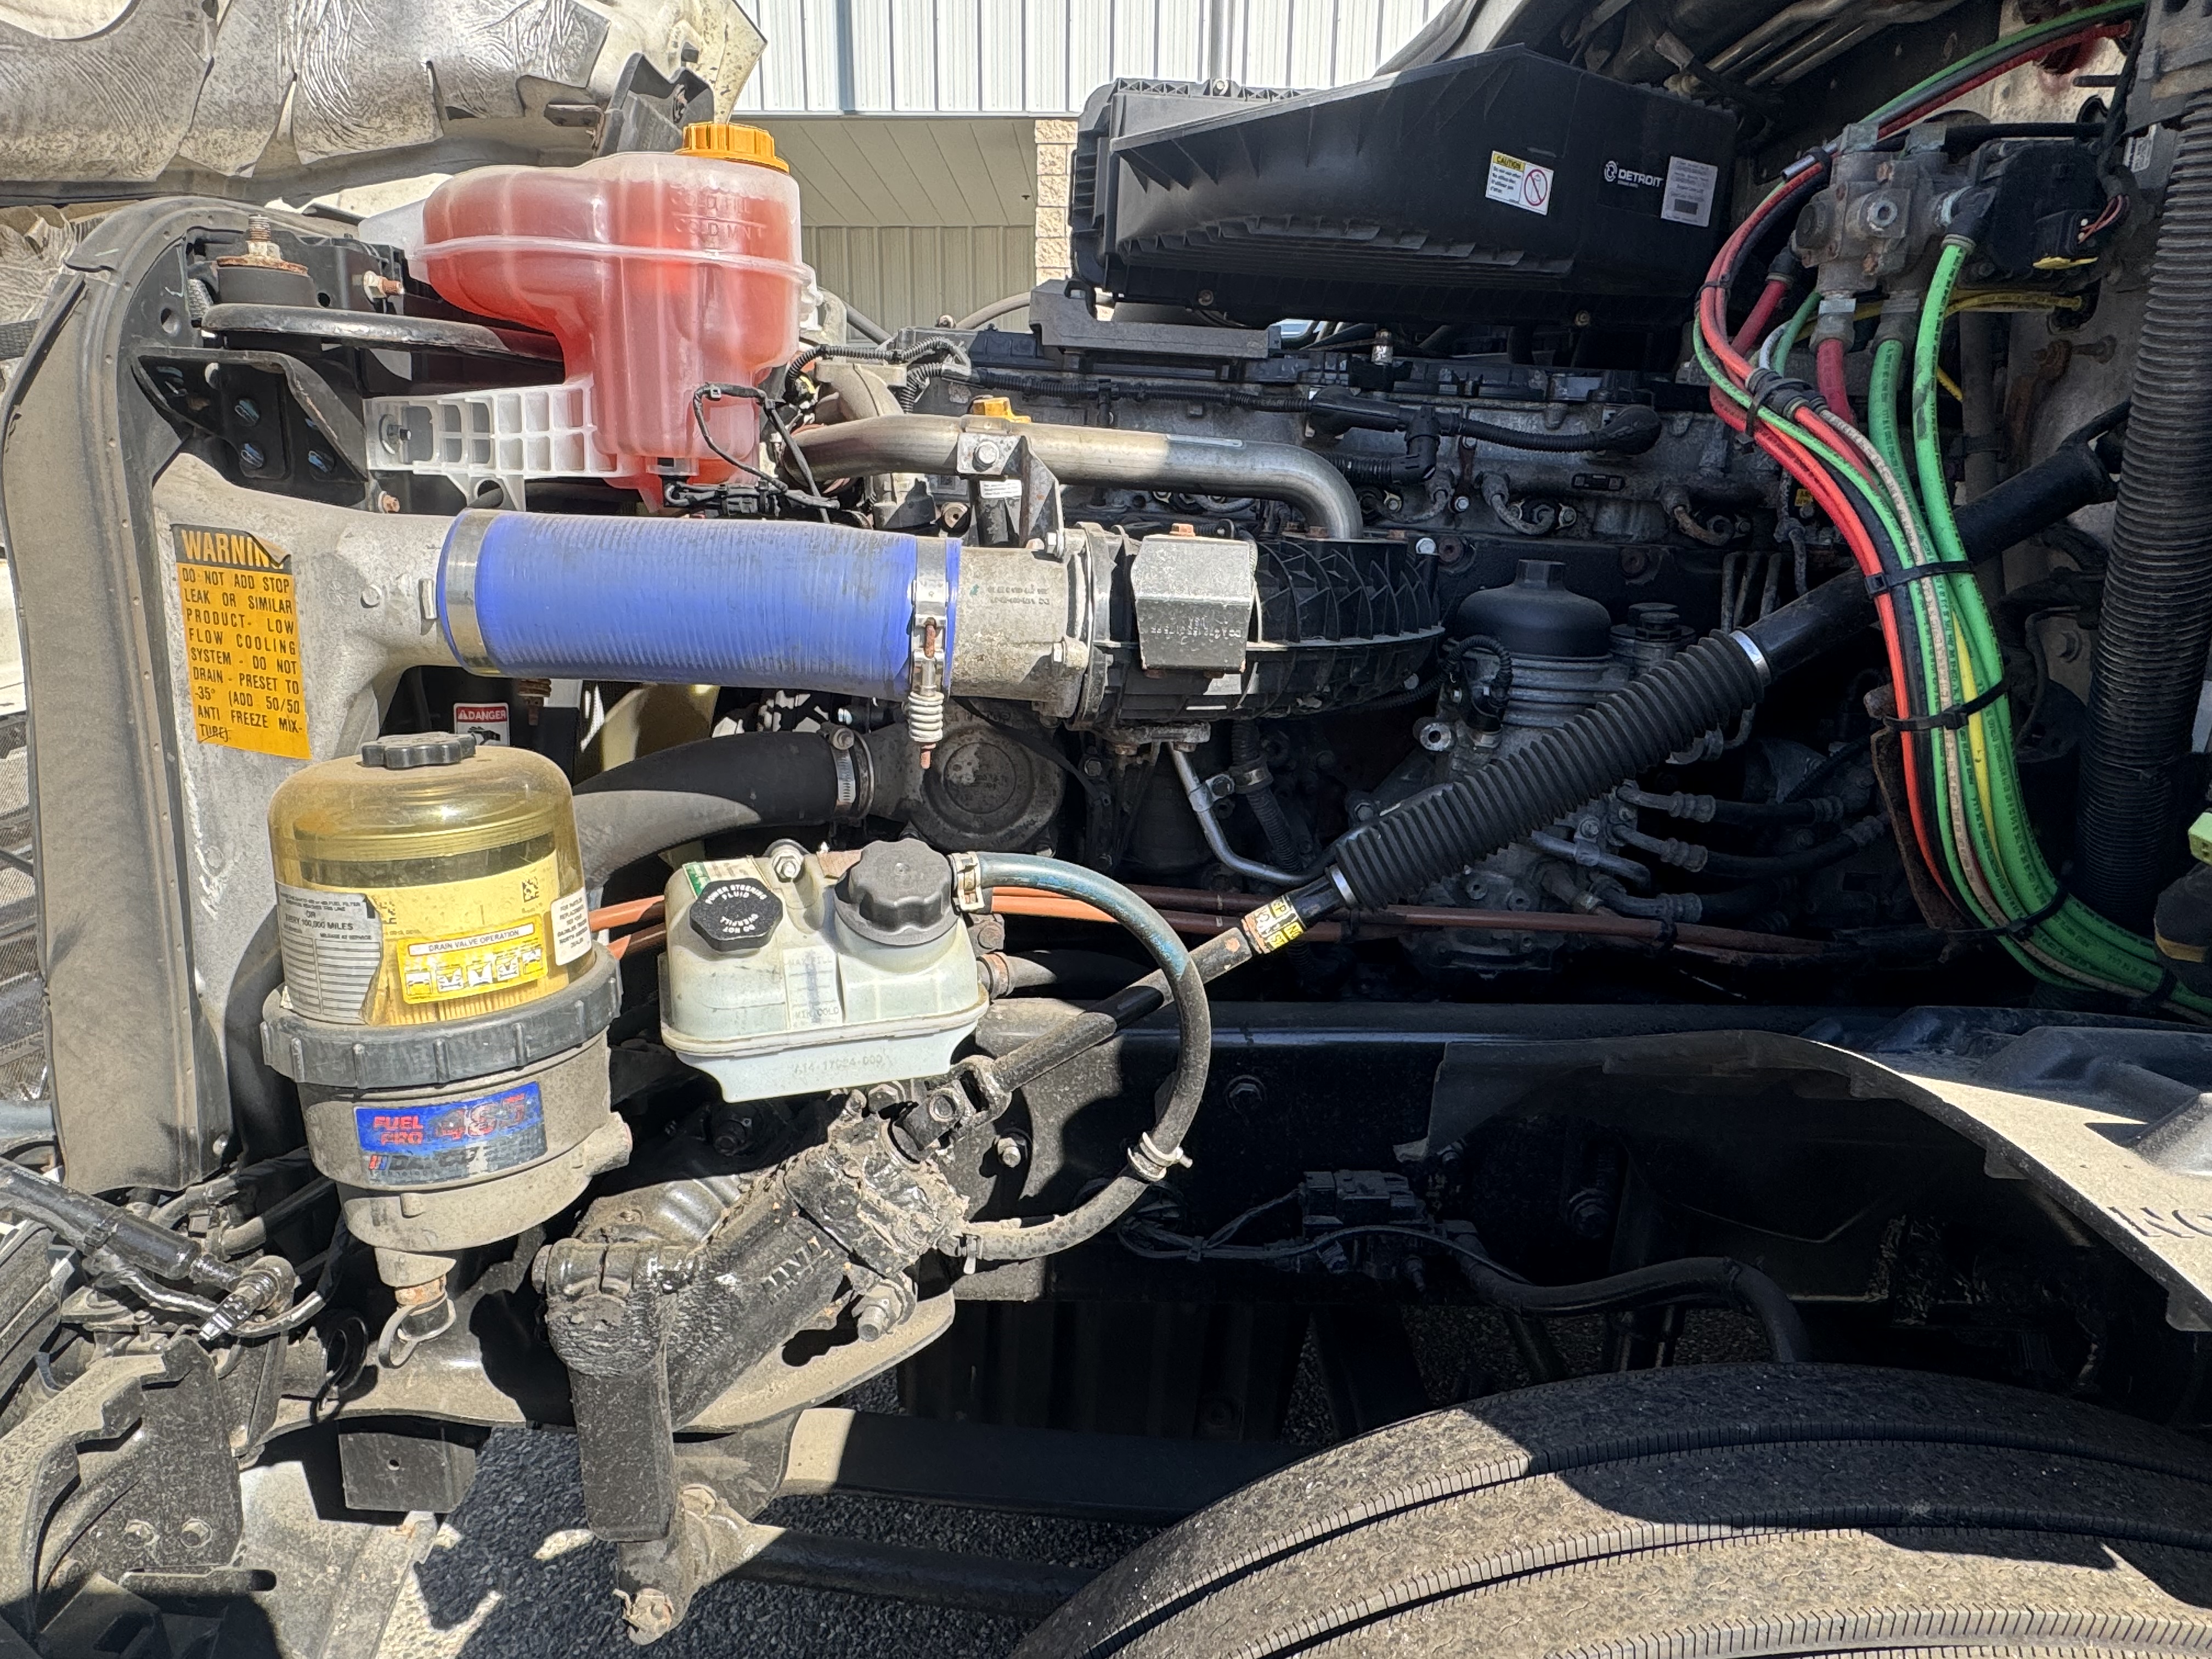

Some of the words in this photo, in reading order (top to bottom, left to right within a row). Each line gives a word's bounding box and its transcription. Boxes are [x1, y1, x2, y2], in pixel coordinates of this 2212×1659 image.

[1618, 169, 1664, 187] DETROIT
[182, 529, 284, 569] WARNIN
[182, 567, 196, 583] DO
[204, 570, 224, 586] NOT
[234, 574, 255, 589] ADD
[263, 577, 290, 594] STOP
[184, 589, 211, 605] LEAK
[222, 592, 236, 607] OR
[248, 596, 293, 615] SIMILAR
[267, 618, 294, 635] LOW
[188, 628, 223, 646] FLOW
[236, 633, 296, 655] COOLING
[190, 647, 232, 665] SYSTEM
[252, 655, 267, 670] DO
[276, 657, 297, 675] NOT
[193, 666, 223, 684] DRAIN
[239, 673, 278, 692] PRESET
[285, 678, 300, 695] TO
[228, 690, 253, 707] (ADD
[266, 697, 300, 715] 50/50
[198, 704, 221, 721] ANTI
[230, 709, 269, 729] FREEZE
[279, 716, 303, 734] MIX-
[469, 710, 506, 720] DANGER
[302, 919, 326, 929] 100,000
[327, 922, 354, 930] MILES
[306, 910, 316, 918] OR
[428, 943, 453, 952] DRAIN
[455, 938, 478, 948] VALVE
[479, 929, 519, 943] OPERATION
[373, 1115, 424, 1130] FUEL
[381, 1131, 424, 1146] PRO
